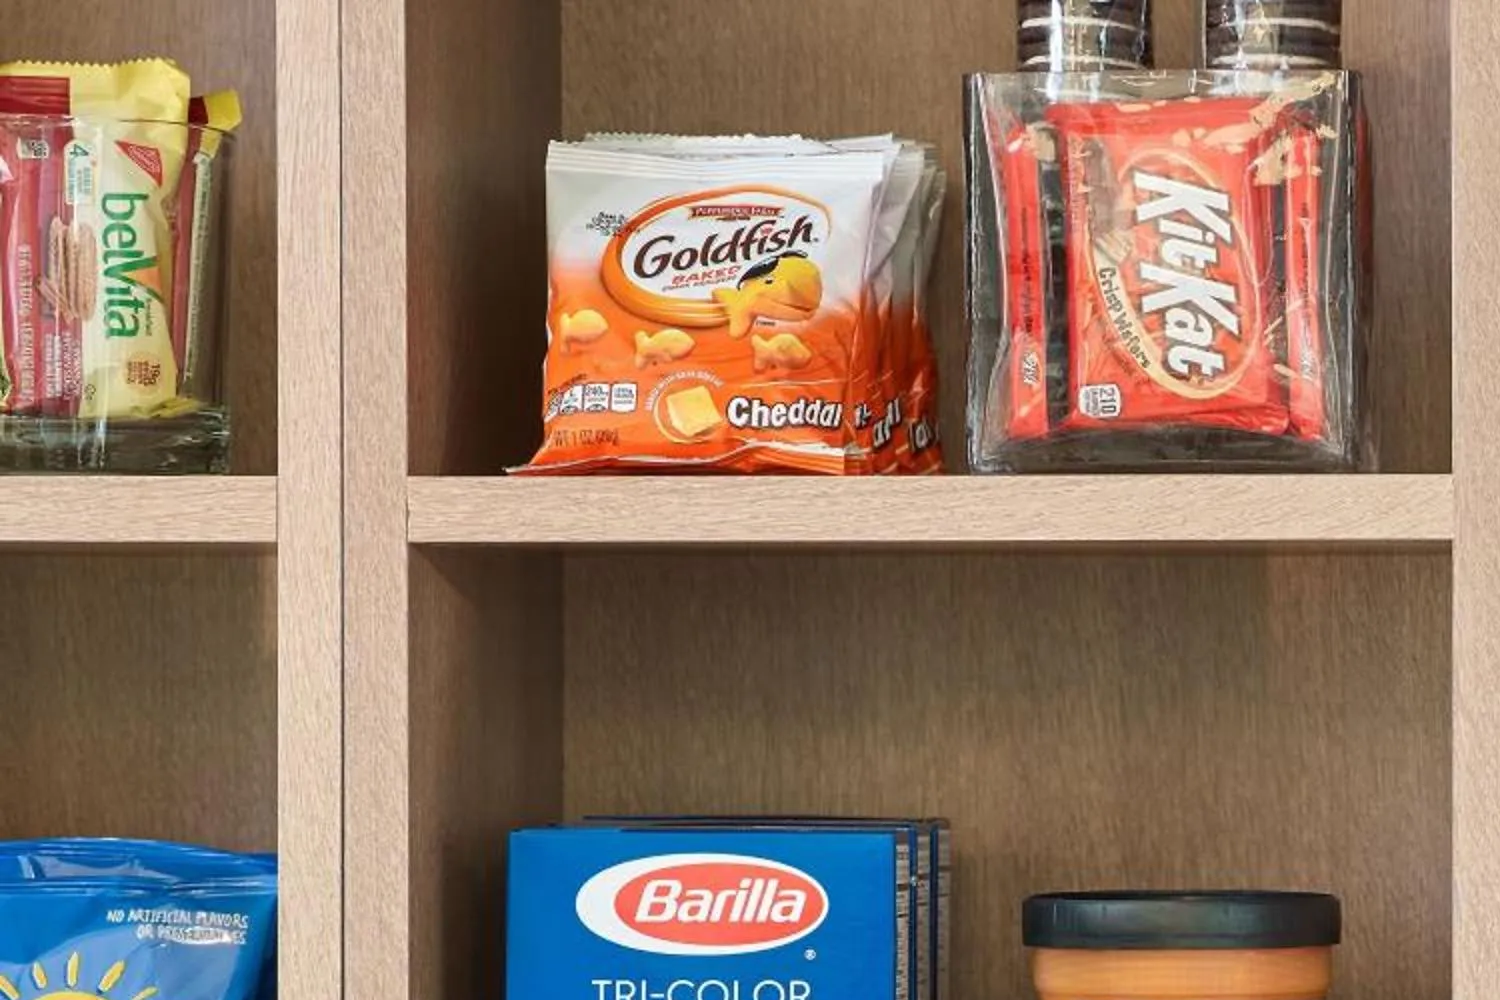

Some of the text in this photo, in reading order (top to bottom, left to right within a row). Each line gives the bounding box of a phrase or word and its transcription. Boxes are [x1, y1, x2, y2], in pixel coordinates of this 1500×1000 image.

[100, 193, 163, 339] belVita
[633, 214, 816, 279] Goldfish
[1099, 267, 1123, 311] Crisp
[1100, 388, 1116, 414] 210
[106, 909, 125, 923] NO
[128, 908, 192, 925] ARTIFICIAL
[634, 878, 807, 924] Barilla
